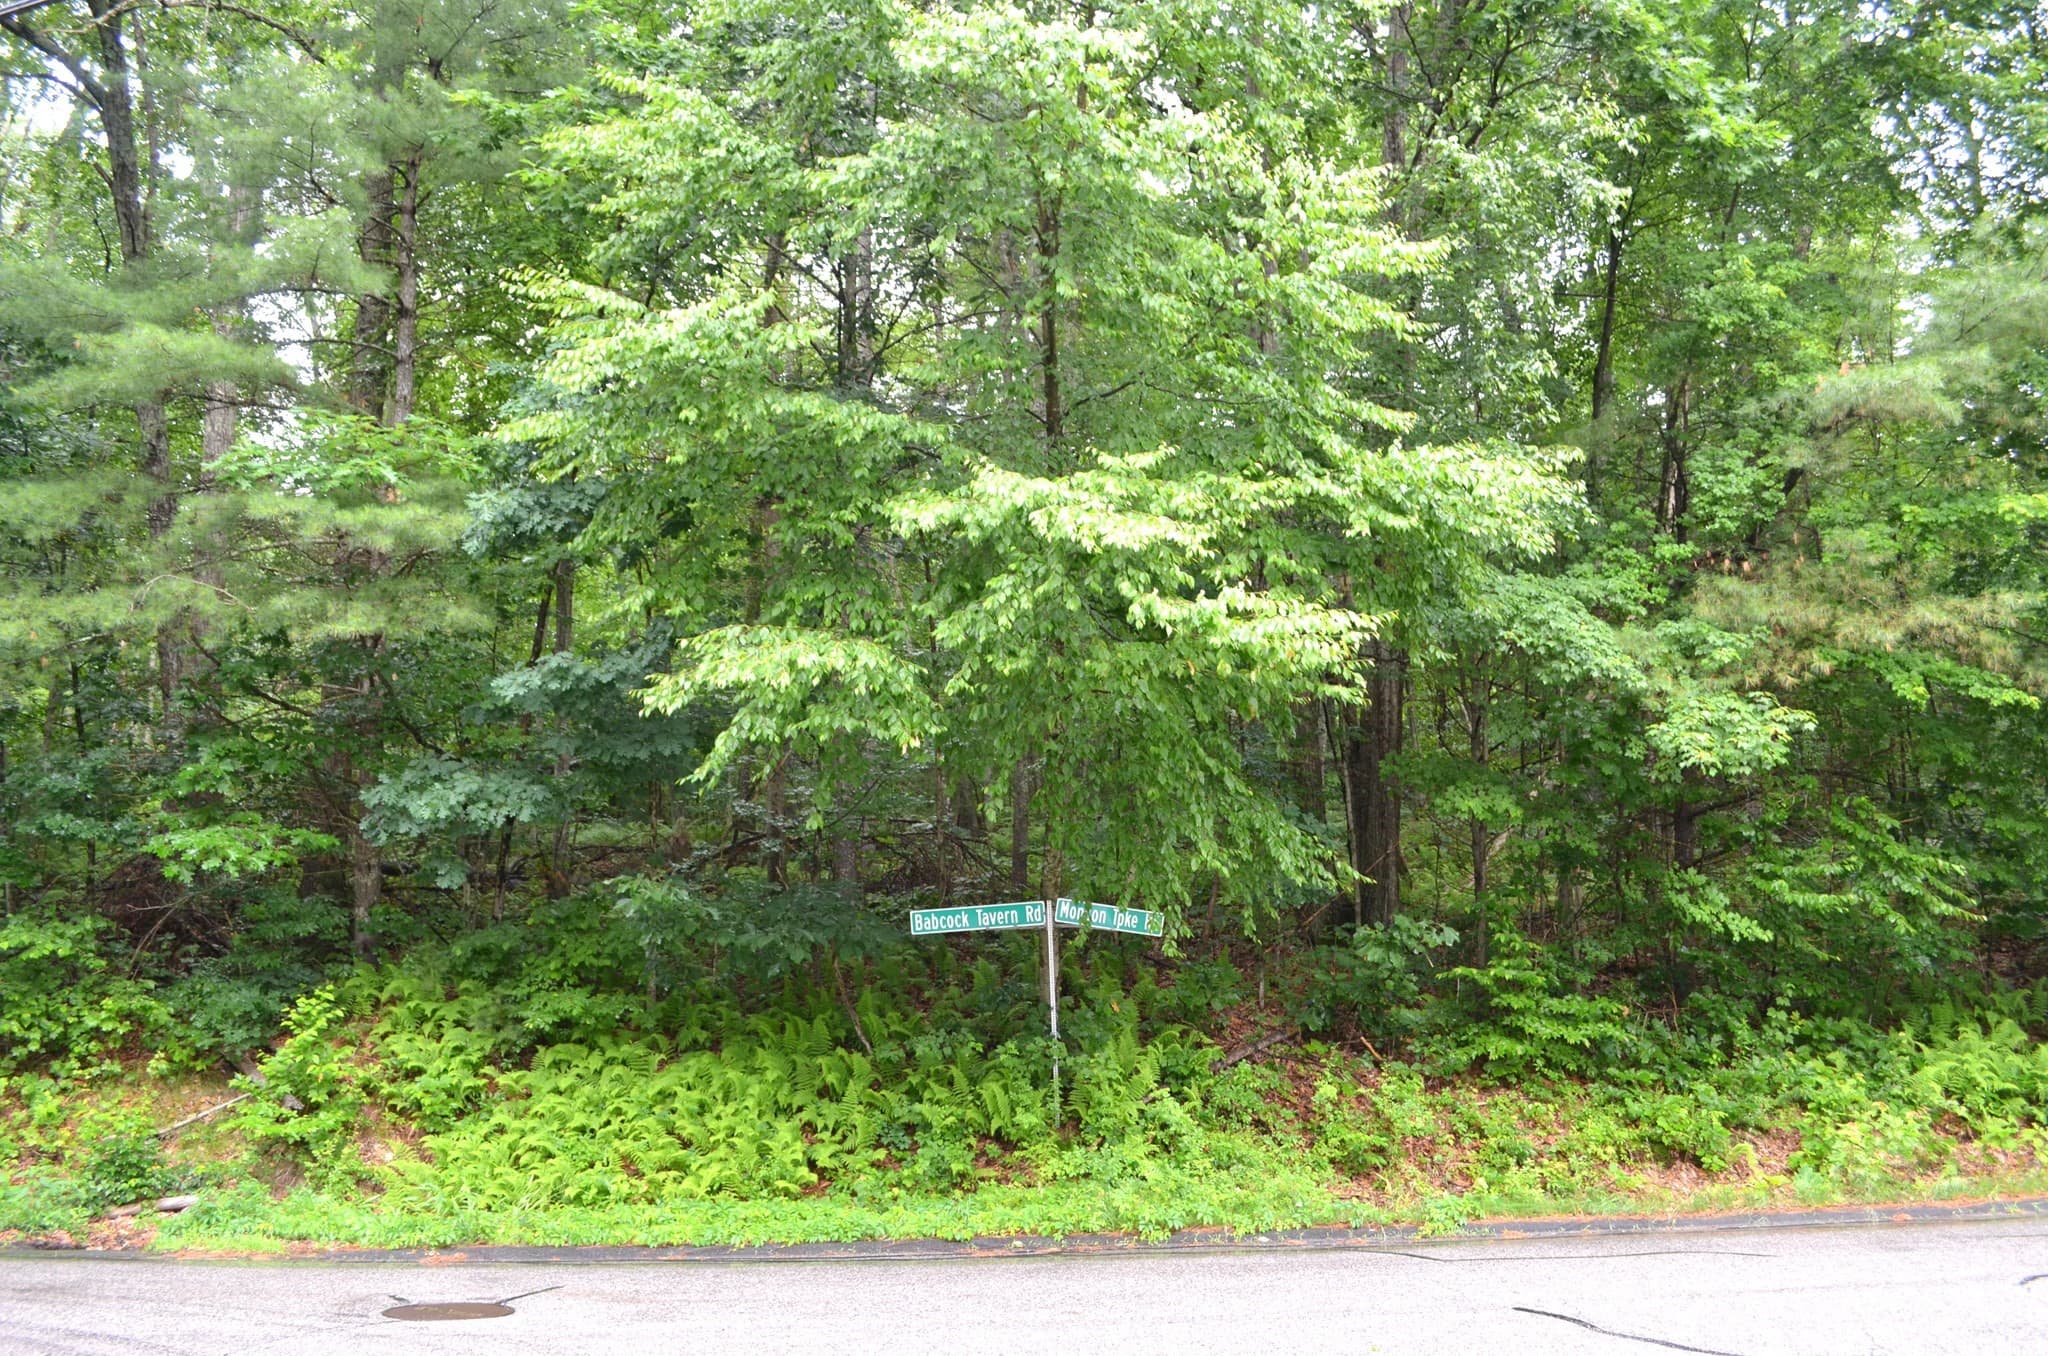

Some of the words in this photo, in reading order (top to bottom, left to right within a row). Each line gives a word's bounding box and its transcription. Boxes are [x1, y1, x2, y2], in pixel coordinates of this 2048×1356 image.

[915, 911, 969, 931] Babcock
[976, 909, 1018, 926] Tavern
[1026, 905, 1041, 922] Rd
[1060, 901, 1106, 924] Monon
[1112, 908, 1138, 928] Tpke
